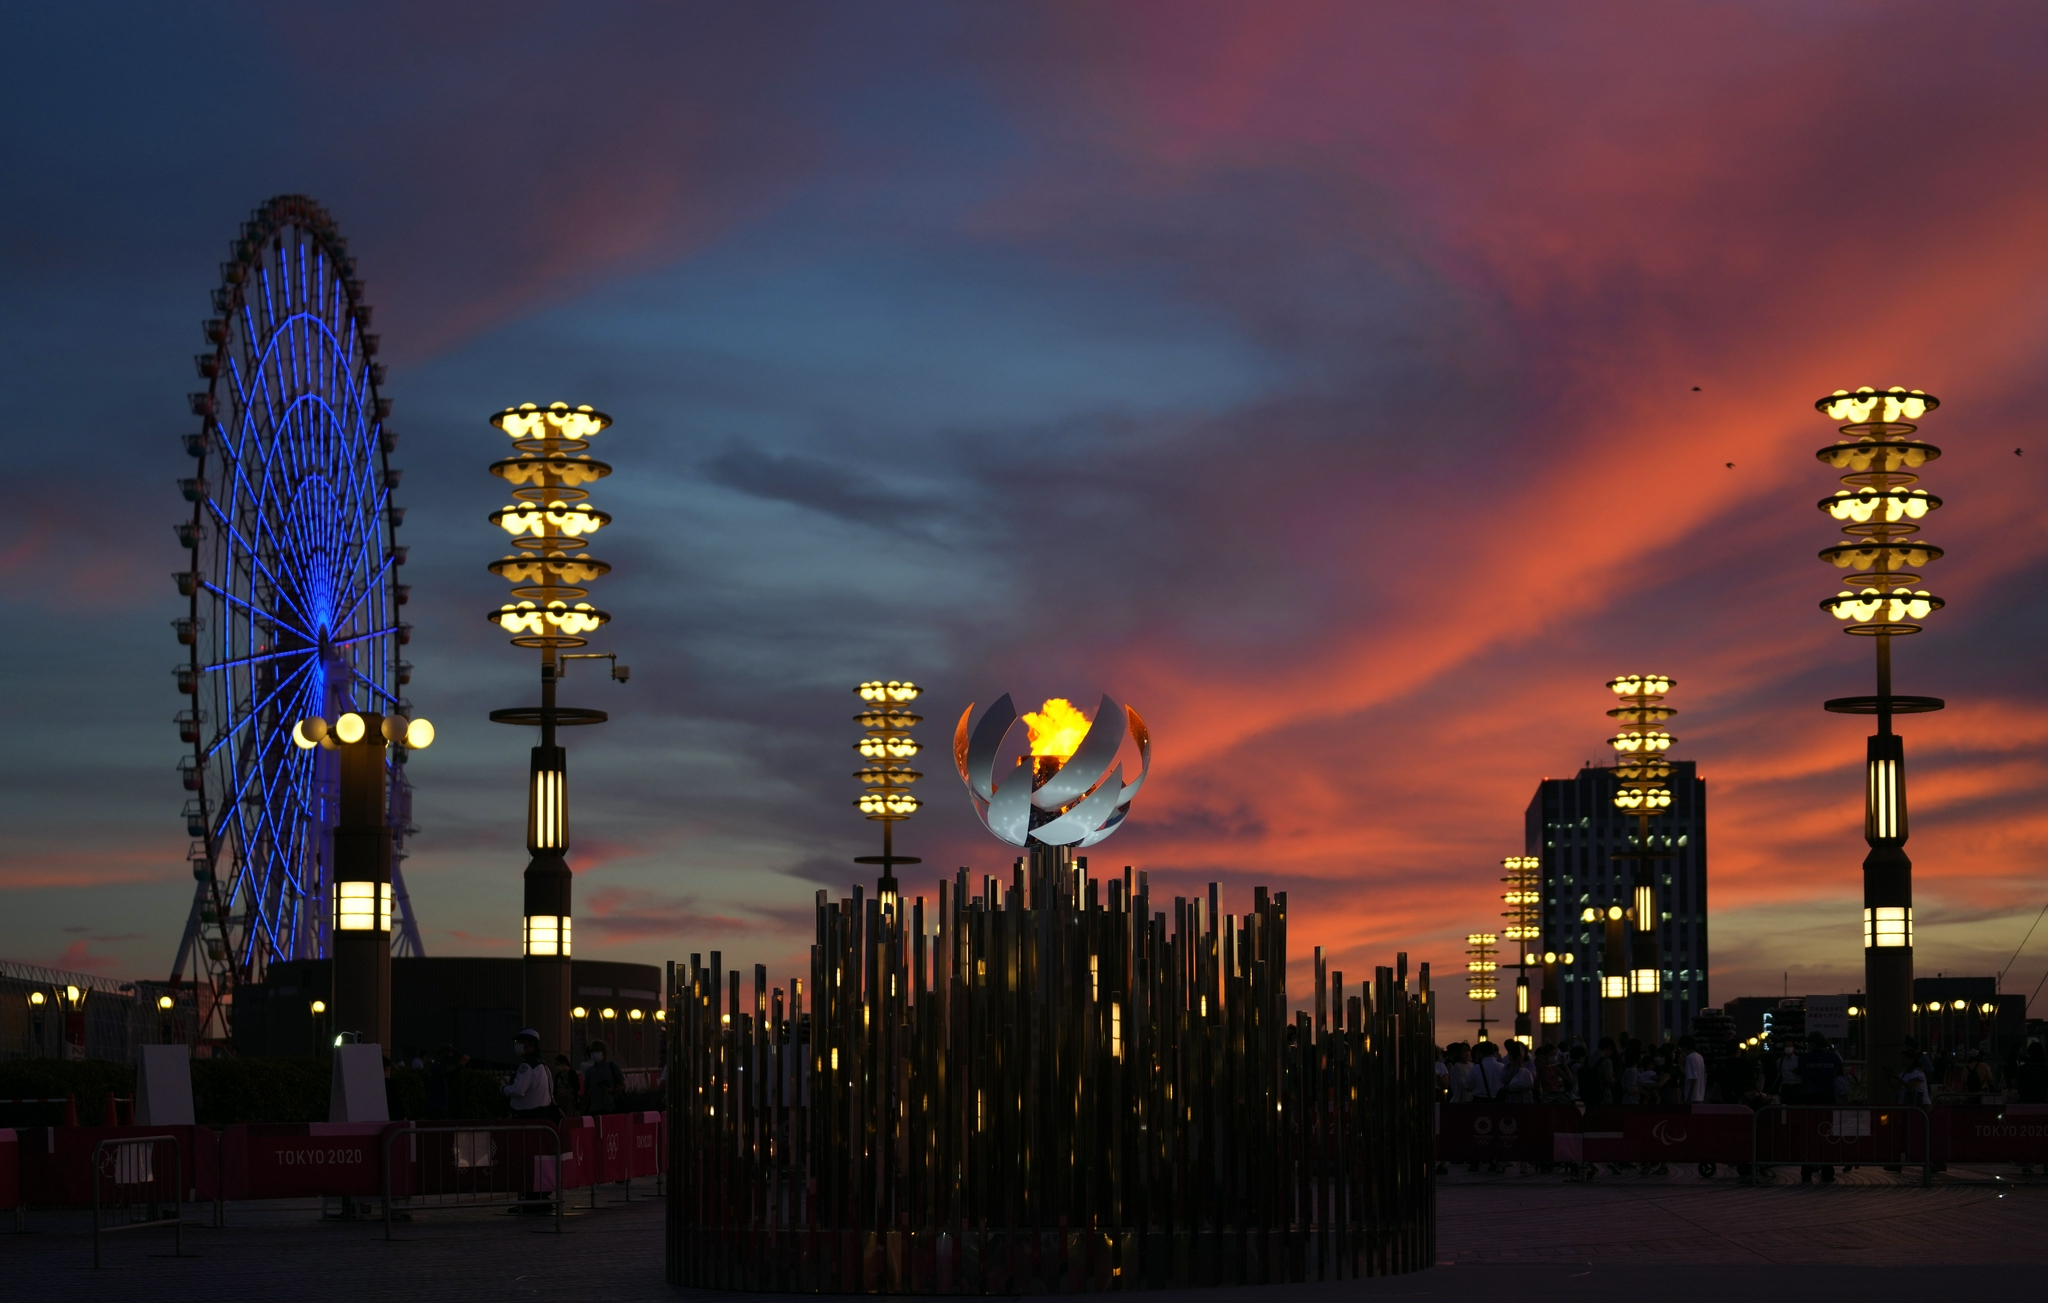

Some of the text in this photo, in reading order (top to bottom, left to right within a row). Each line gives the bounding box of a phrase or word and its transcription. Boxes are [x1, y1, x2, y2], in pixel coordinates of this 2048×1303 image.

[1975, 1125, 2017, 1137] TOKYO
[276, 1149, 362, 1165] TOKYO 2020
